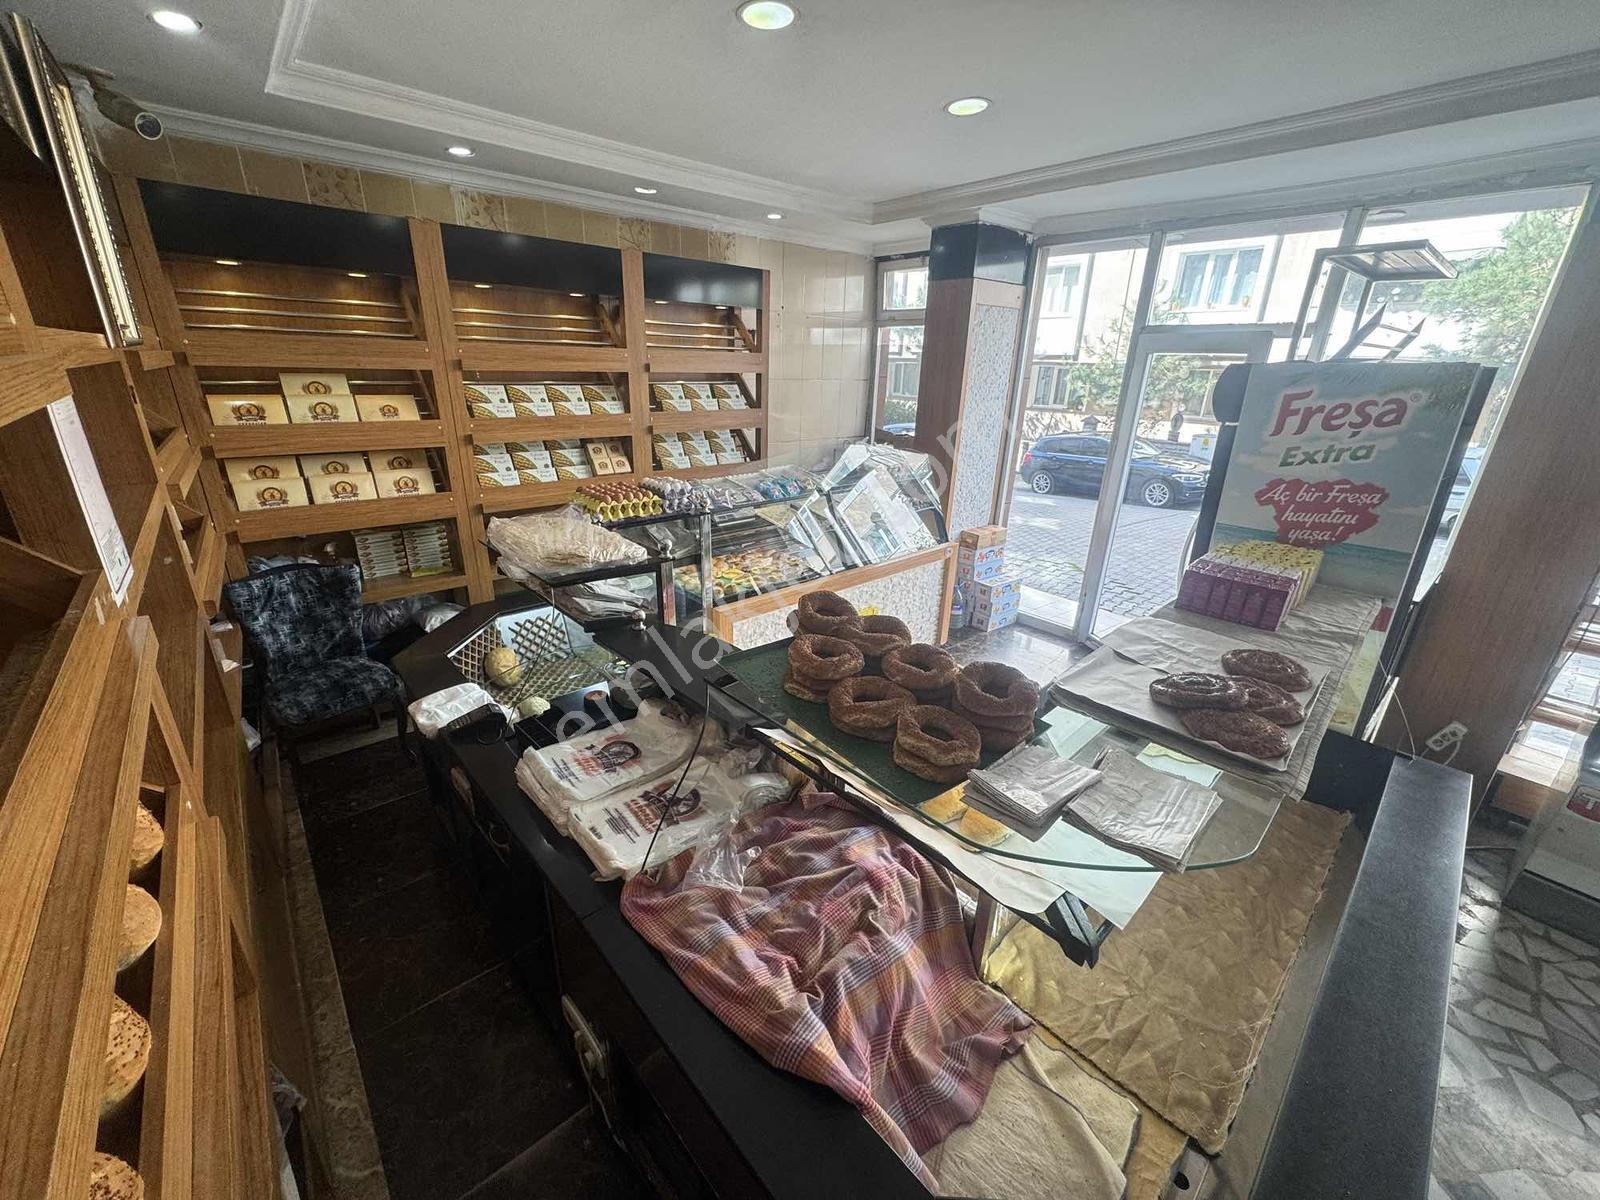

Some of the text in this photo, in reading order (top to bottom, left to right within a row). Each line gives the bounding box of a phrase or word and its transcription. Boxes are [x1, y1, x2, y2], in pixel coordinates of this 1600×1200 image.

[1269, 389, 1408, 438] Freşa
[1278, 443, 1376, 468] Extra
[1261, 484, 1384, 506] Aç bir Freşa
[1287, 526, 1342, 543] yaşa!
